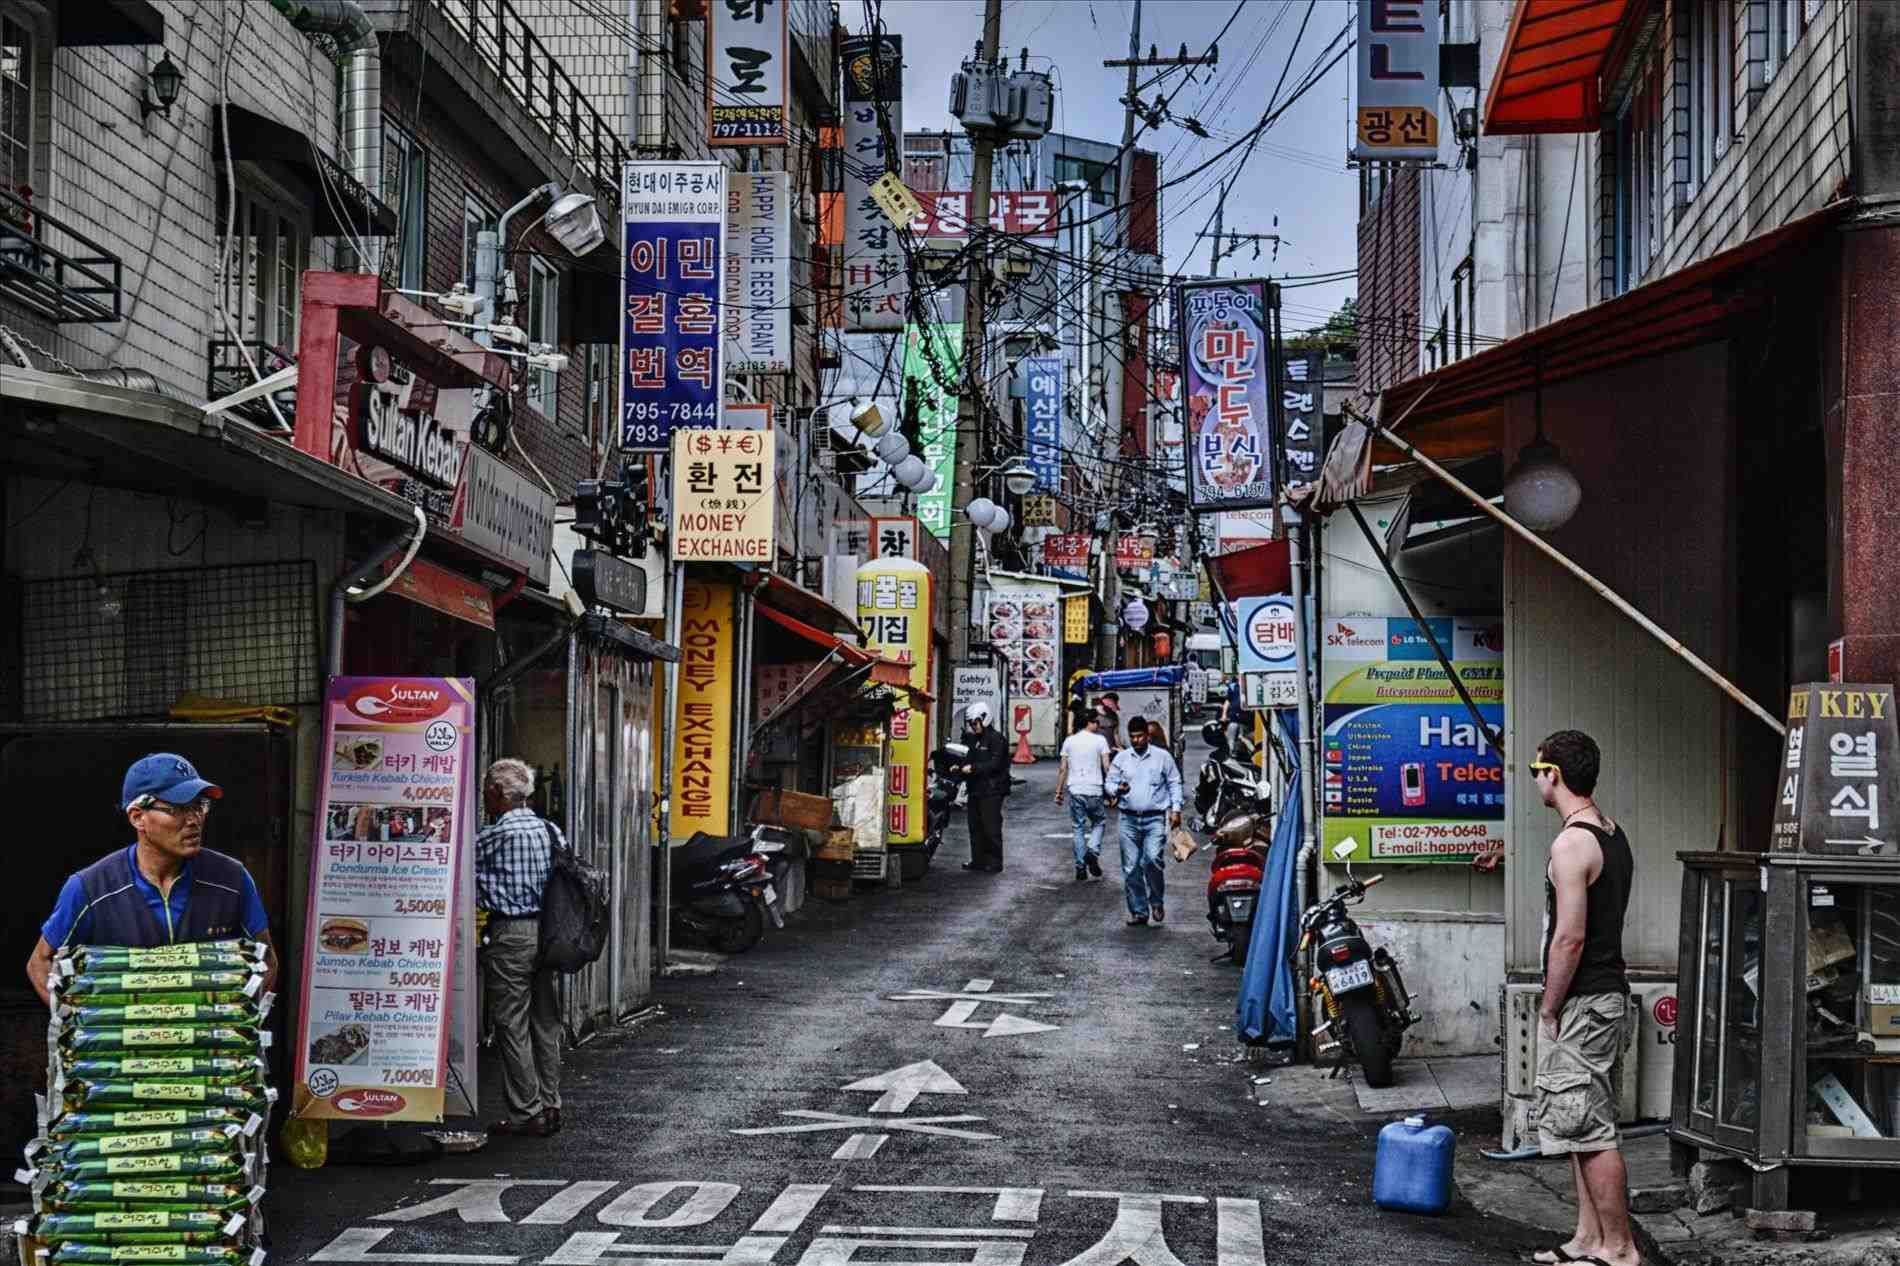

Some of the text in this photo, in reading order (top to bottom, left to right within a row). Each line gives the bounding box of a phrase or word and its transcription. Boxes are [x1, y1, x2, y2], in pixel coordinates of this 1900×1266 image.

[713, 123, 784, 137] 797-1112
[628, 172, 720, 194] 현대이주공사
[628, 201, 649, 214] HYUN
[652, 201, 666, 214] DAI
[668, 201, 694, 214] EMIGR
[631, 238, 714, 280] 이민
[751, 176, 774, 357] HAPPY HOME RESTAURANT
[628, 292, 717, 334] 결혼
[630, 347, 713, 390] 번역
[1204, 330, 1255, 428] 만두
[625, 403, 716, 421] 795-7844
[368, 387, 460, 488] Sultan Kebab
[625, 426, 714, 443] 793-
[1204, 434, 1262, 471] 분식
[687, 462, 762, 494] 환전
[679, 514, 746, 531] MONEY
[678, 539, 768, 556] EXCHANGE
[858, 615, 908, 645] 기집
[1255, 622, 1297, 643] 담배
[1327, 634, 1344, 647] SK
[686, 619, 720, 692] MONEY
[390, 684, 439, 701] SULTAN
[1820, 691, 1889, 719] KEY
[385, 754, 456, 774] 터키 케밥
[681, 703, 715, 818] EXCHANGE
[1347, 764, 1384, 772] Australia
[332, 772, 455, 784] Turkish Kebab Chicken
[1829, 731, 1879, 830] 열쇠
[402, 786, 453, 802] 4,000원
[329, 843, 450, 866] 터키 아이스크림
[391, 864, 409, 874] Ice
[394, 899, 447, 915] 2,500원
[371, 938, 443, 958] 점보 케밥
[316, 955, 442, 970] Jumbo Kebab Chicken
[389, 971, 441, 988] 5,000원
[348, 991, 440, 1012] 필라프 케밥
[354, 1011, 390, 1022] Kebab
[393, 1012, 439, 1023] Chicken
[382, 1069, 433, 1085] 7,000원
